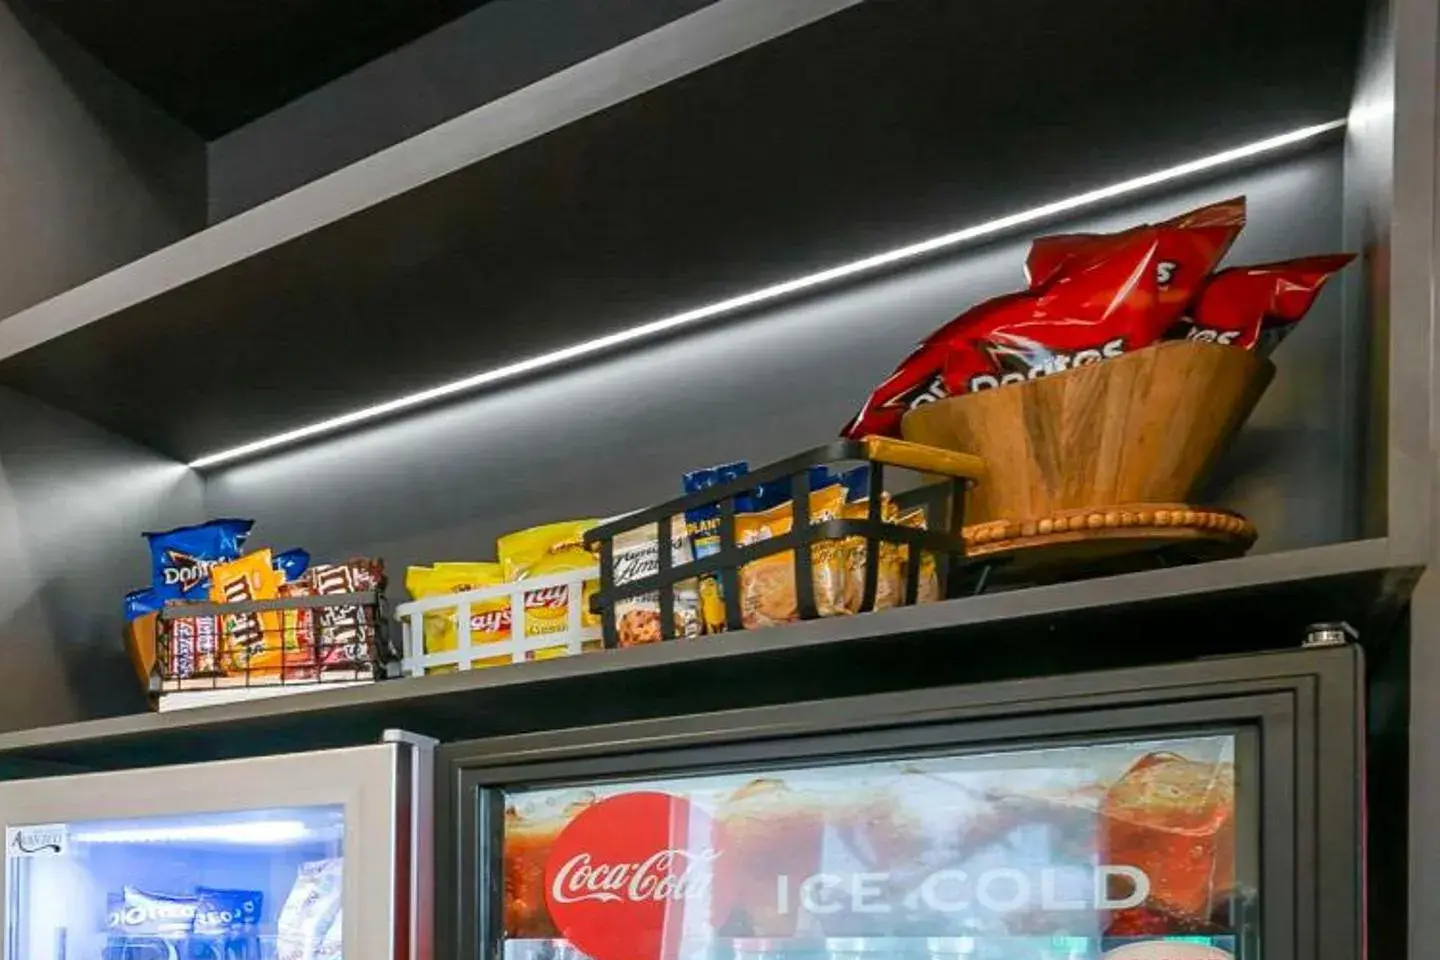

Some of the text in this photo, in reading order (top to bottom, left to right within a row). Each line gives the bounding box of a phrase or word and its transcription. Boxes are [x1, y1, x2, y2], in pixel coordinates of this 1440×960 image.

[552, 848, 724, 904] Coca-Cola
[777, 865, 1151, 915] ICE COLD
